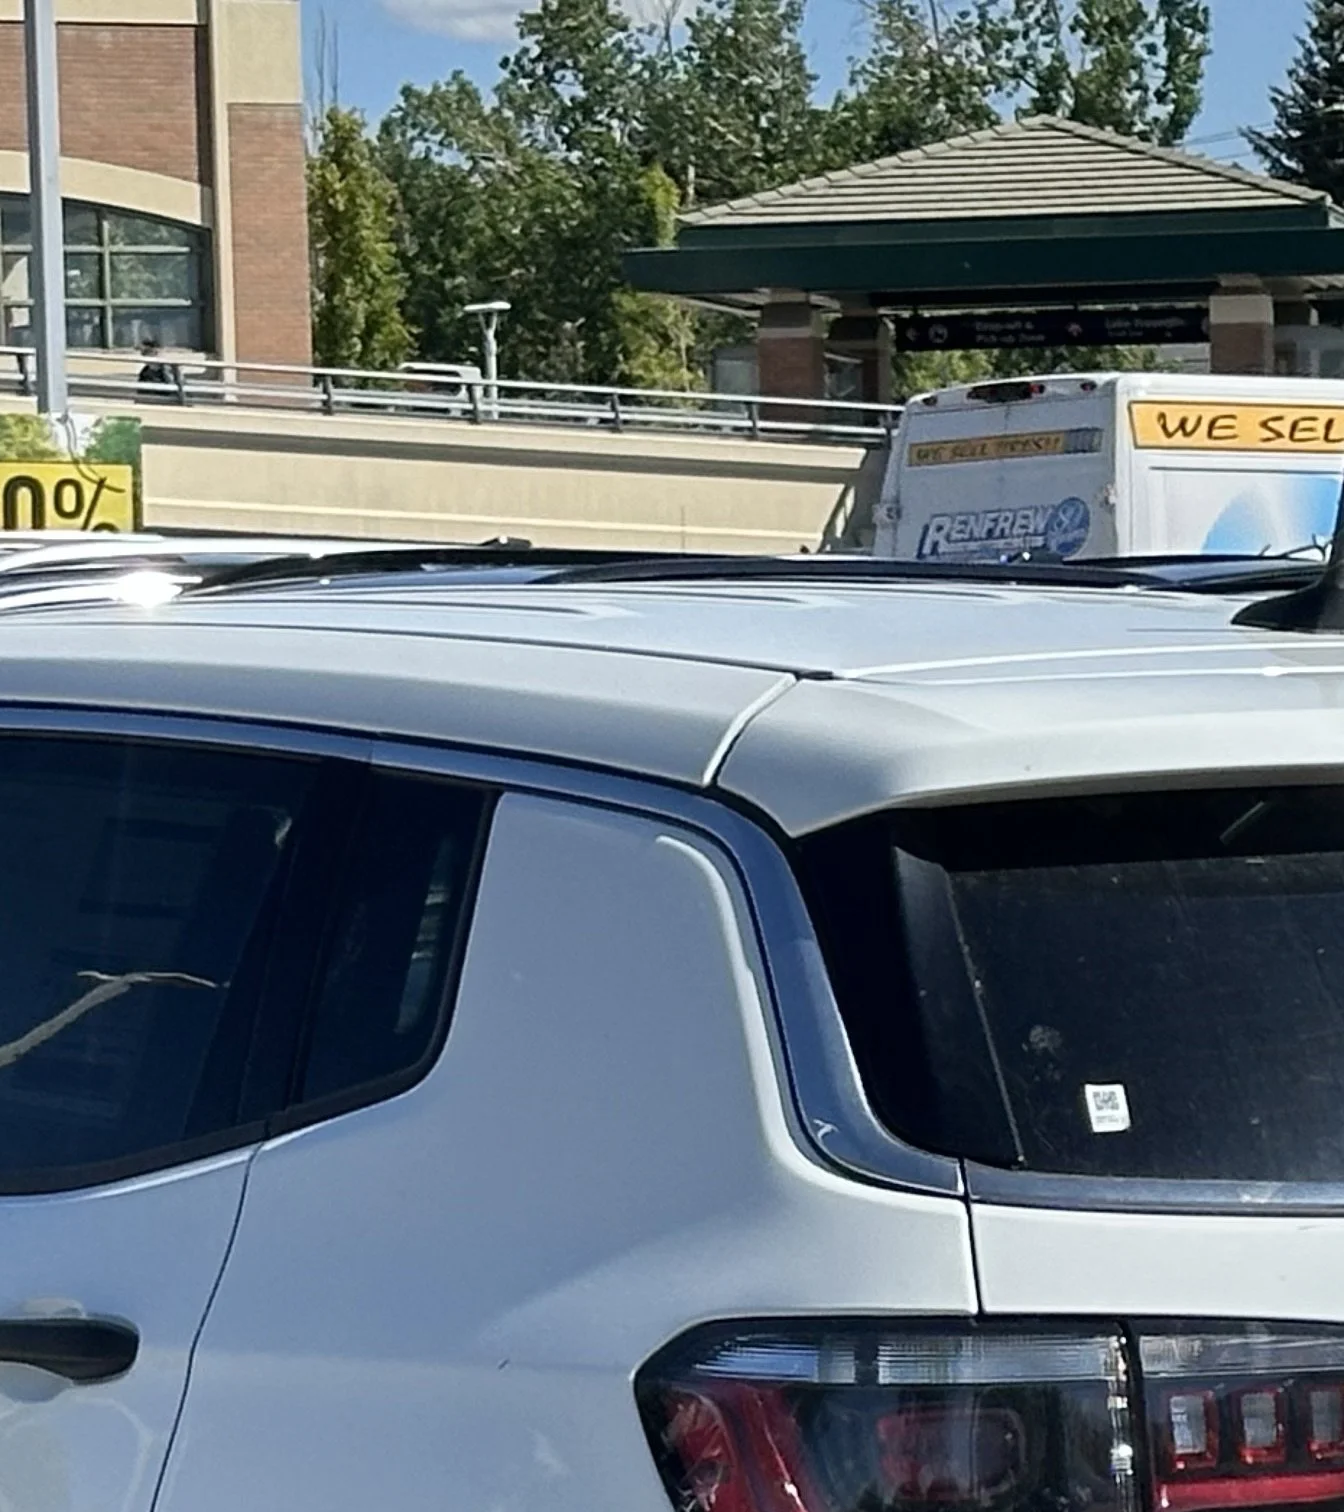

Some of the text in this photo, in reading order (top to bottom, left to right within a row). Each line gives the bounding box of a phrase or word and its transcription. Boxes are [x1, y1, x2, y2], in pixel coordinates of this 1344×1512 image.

[1157, 411, 1239, 440] WE
[2, 474, 121, 531] 0%
[919, 505, 1056, 558] RENFREW
